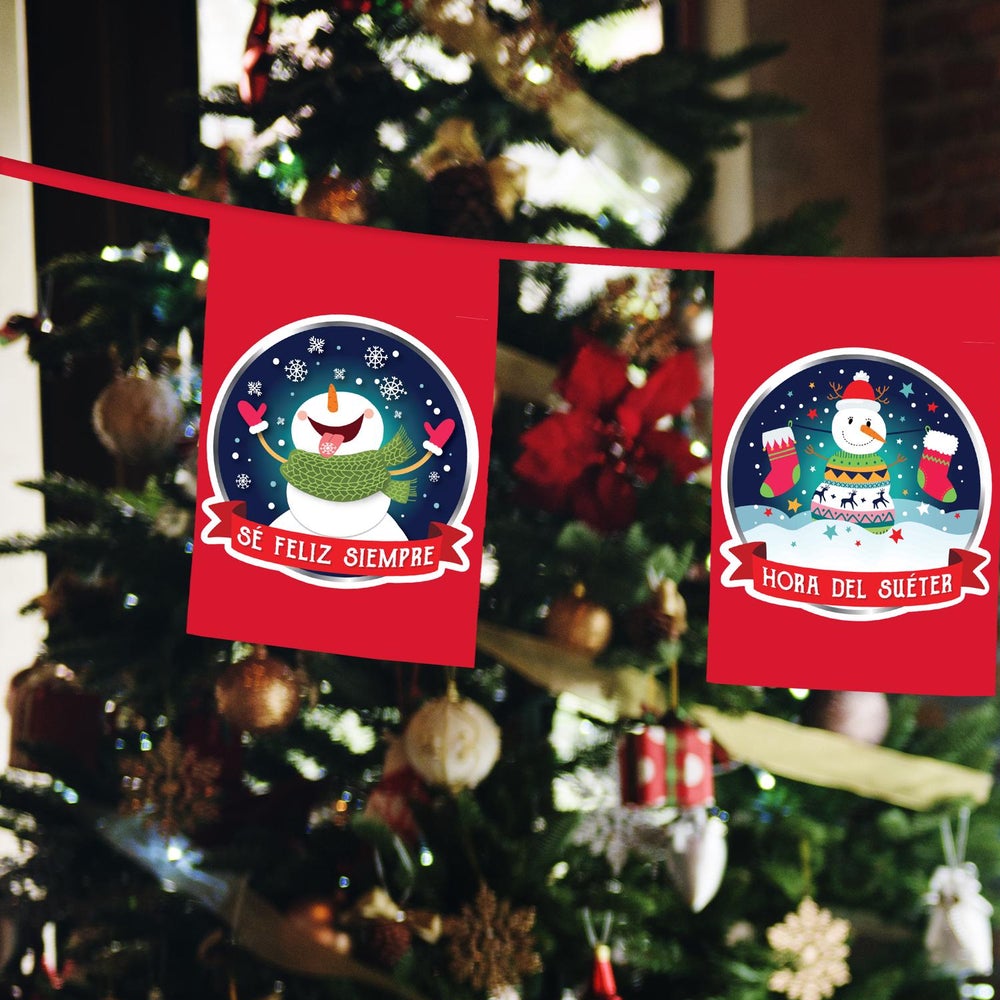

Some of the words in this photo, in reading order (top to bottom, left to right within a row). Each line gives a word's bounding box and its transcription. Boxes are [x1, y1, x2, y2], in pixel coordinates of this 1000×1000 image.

[236, 525, 264, 551] SÉ
[274, 535, 332, 565] FELIZ
[343, 545, 435, 569] SIEMPRE
[761, 565, 821, 596] HORA
[831, 577, 867, 599] DEL
[877, 572, 953, 600] SUÉTER
